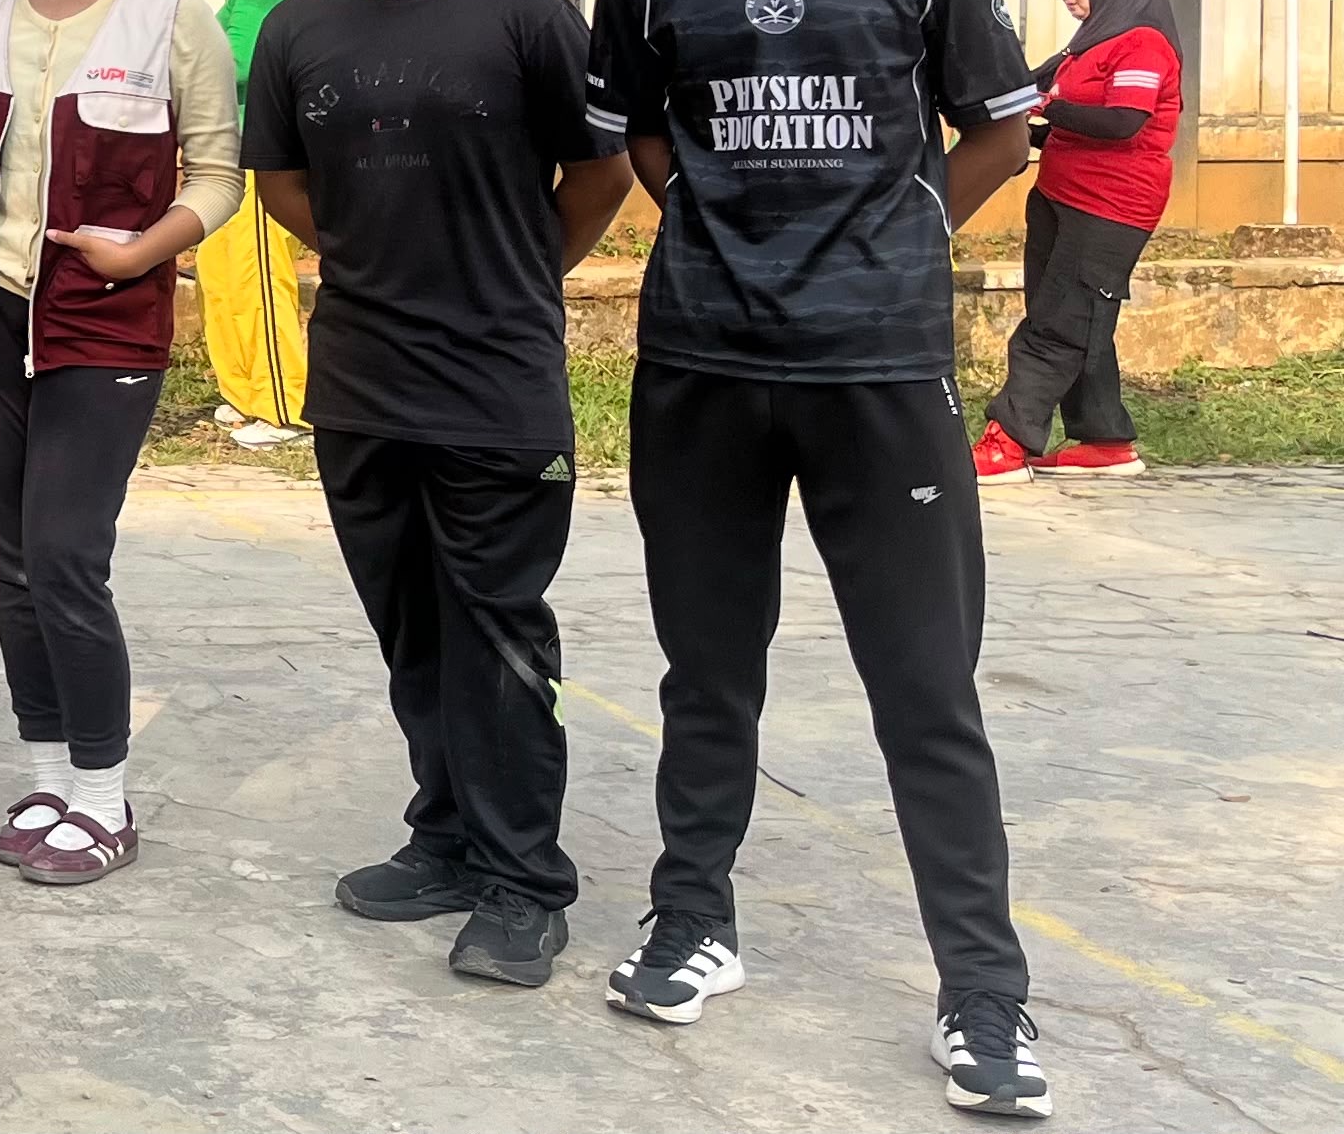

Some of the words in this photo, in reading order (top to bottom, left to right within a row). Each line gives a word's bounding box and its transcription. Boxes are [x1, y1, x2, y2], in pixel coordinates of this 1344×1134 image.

[100, 67, 126, 82] UPI
[708, 75, 863, 113] PHYSICAL
[708, 114, 874, 151] EDUCATION
[770, 158, 844, 168] SUMEDANG
